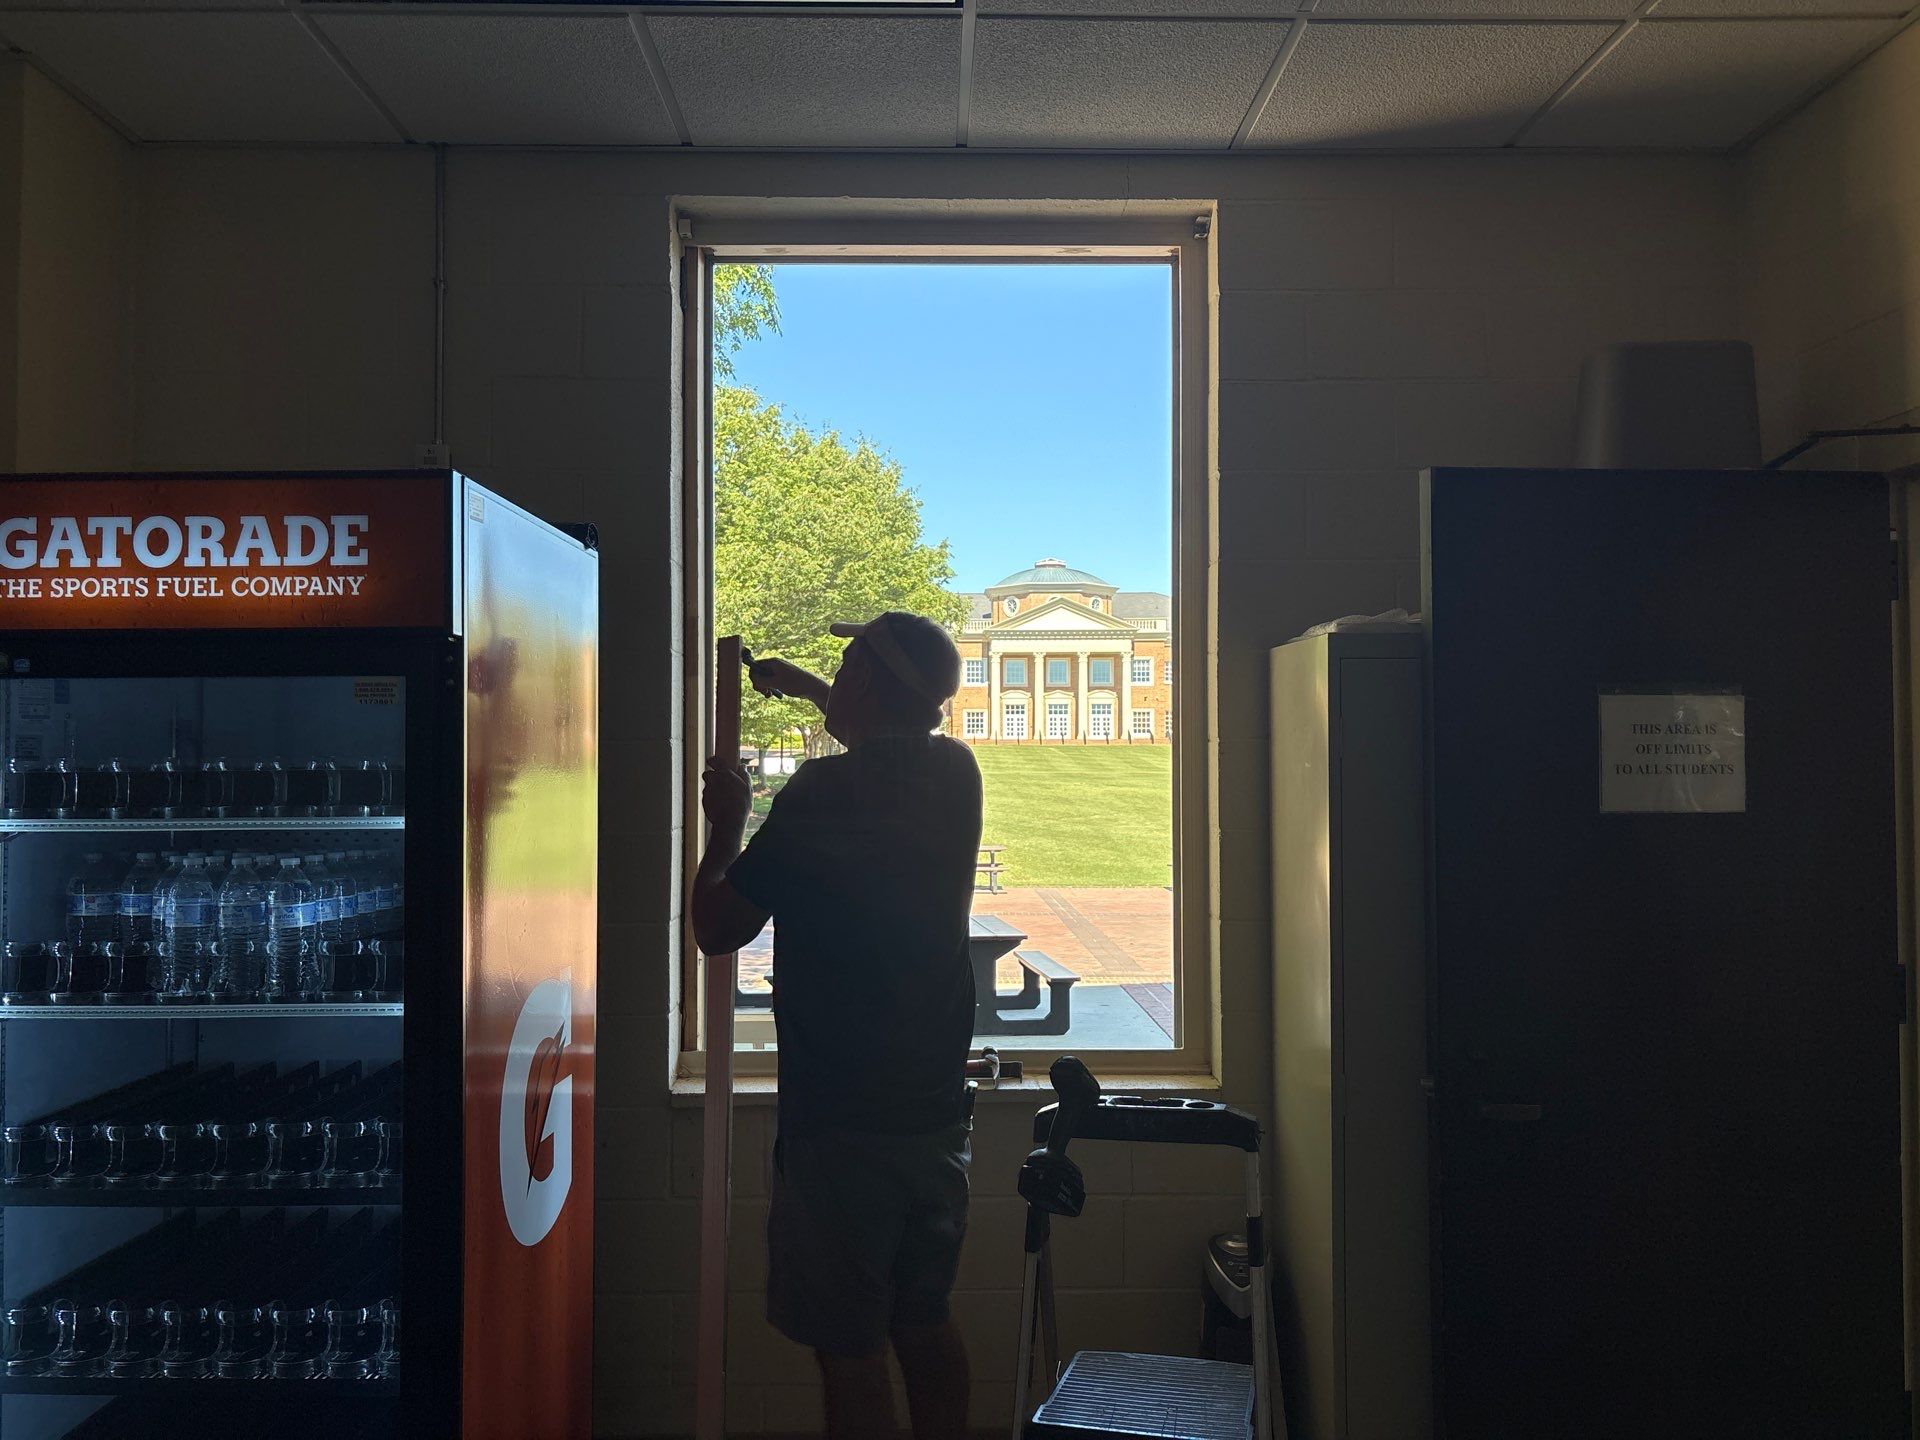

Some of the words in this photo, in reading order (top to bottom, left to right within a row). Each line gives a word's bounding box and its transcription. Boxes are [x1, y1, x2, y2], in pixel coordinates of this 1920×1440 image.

[0, 514, 369, 569] GATORADE
[50, 577, 149, 598] SPORTS
[156, 577, 224, 597] FUEL
[231, 575, 365, 597] COMPANY
[1632, 723, 1661, 734] THIS
[1664, 723, 1701, 735] AREA
[1705, 724, 1717, 735] IS
[1636, 744, 1661, 754] OFF
[1664, 744, 1712, 754] LIMITS
[1615, 764, 1632, 774] TO
[1636, 764, 1661, 774] ALL
[1665, 764, 1735, 774] STUDENTS
